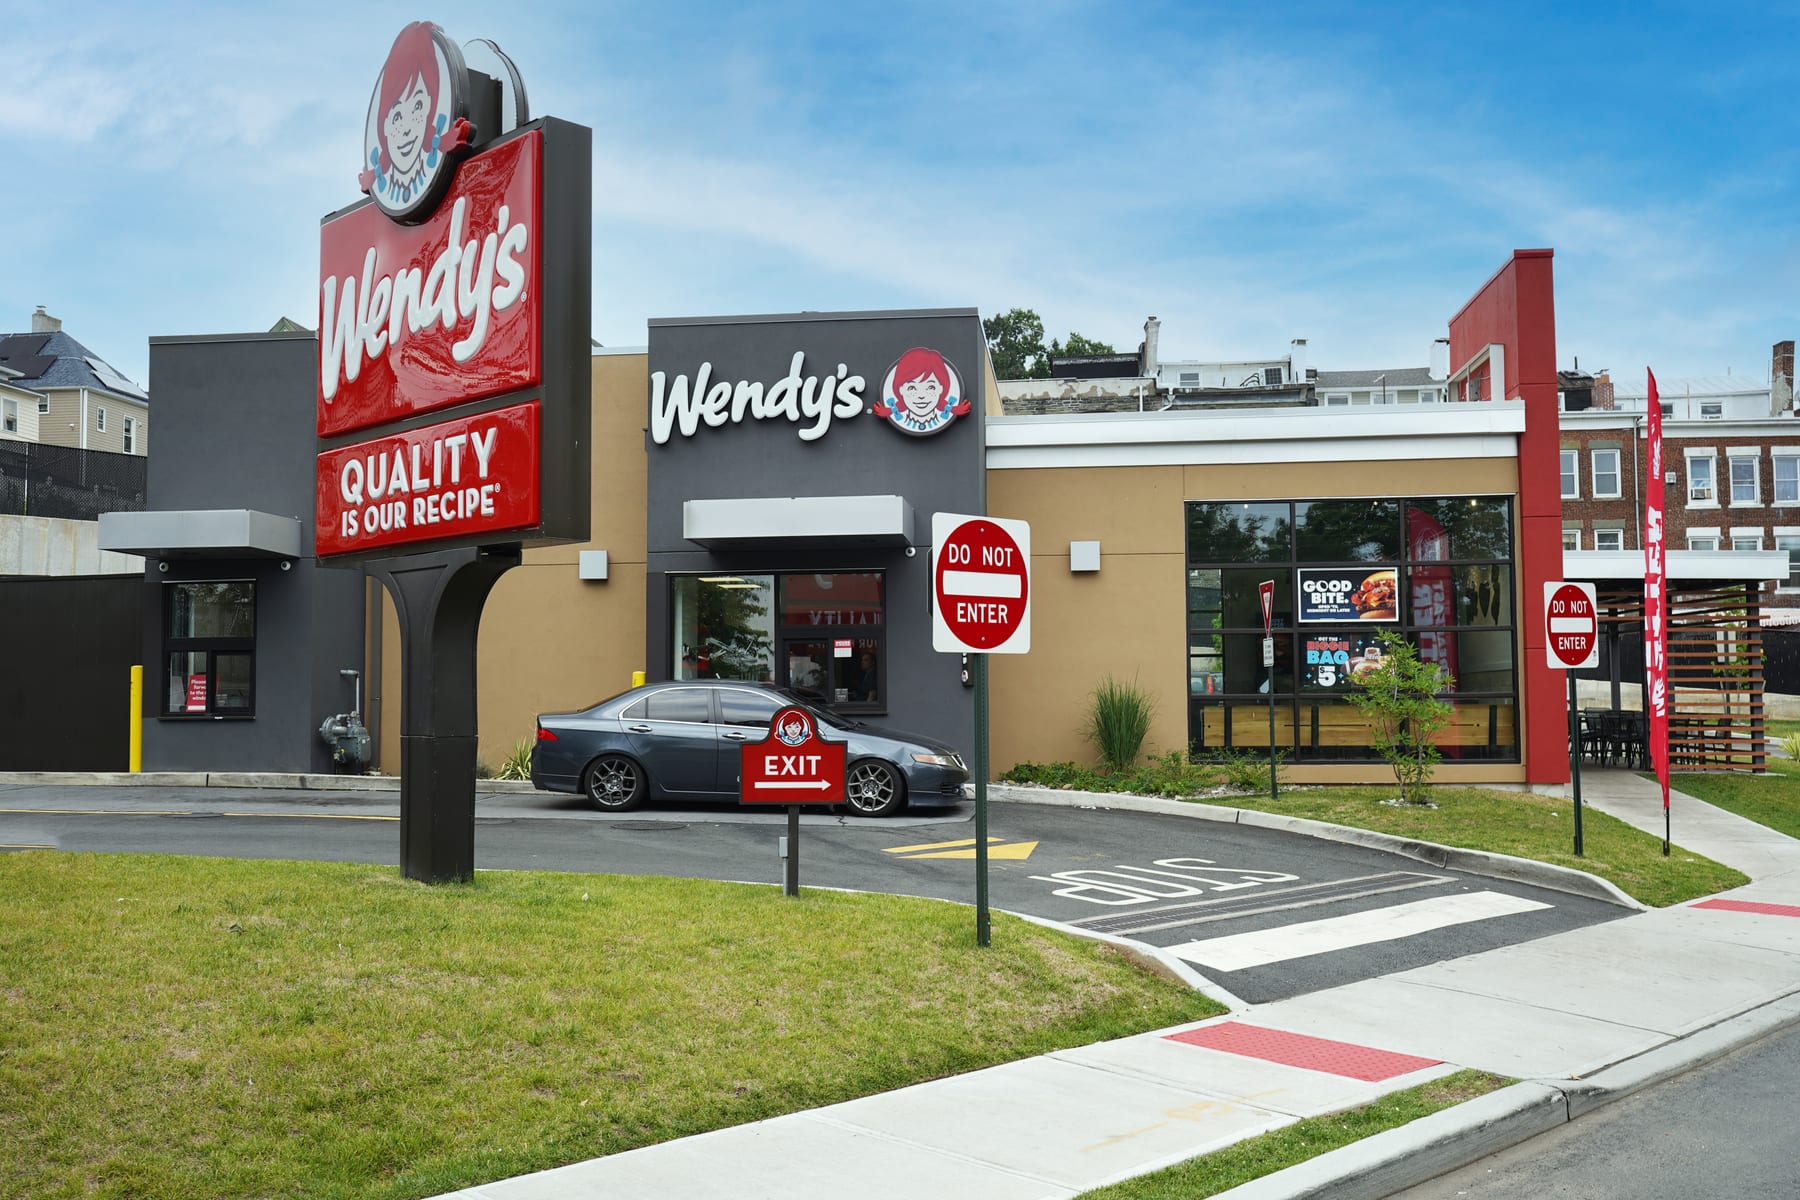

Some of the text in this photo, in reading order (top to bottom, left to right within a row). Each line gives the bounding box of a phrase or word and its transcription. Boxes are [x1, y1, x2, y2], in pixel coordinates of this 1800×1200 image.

[321, 196, 528, 403] Wendy's
[651, 351, 866, 444] Wendy's
[341, 427, 497, 506] QUALITY
[341, 509, 359, 537] IS
[364, 501, 407, 533] OUR
[948, 543, 1014, 567] DO NOT
[1303, 580, 1352, 592] GOOD
[1311, 593, 1349, 604] BITE.
[1553, 600, 1588, 614] DO NOT
[957, 602, 1008, 624] ENTER
[1307, 641, 1349, 650] BIGGIE
[1558, 636, 1587, 650] ENTER
[1307, 650, 1349, 664] BAG
[764, 755, 822, 776] EXIT
[1028, 858, 1300, 906] STOP
